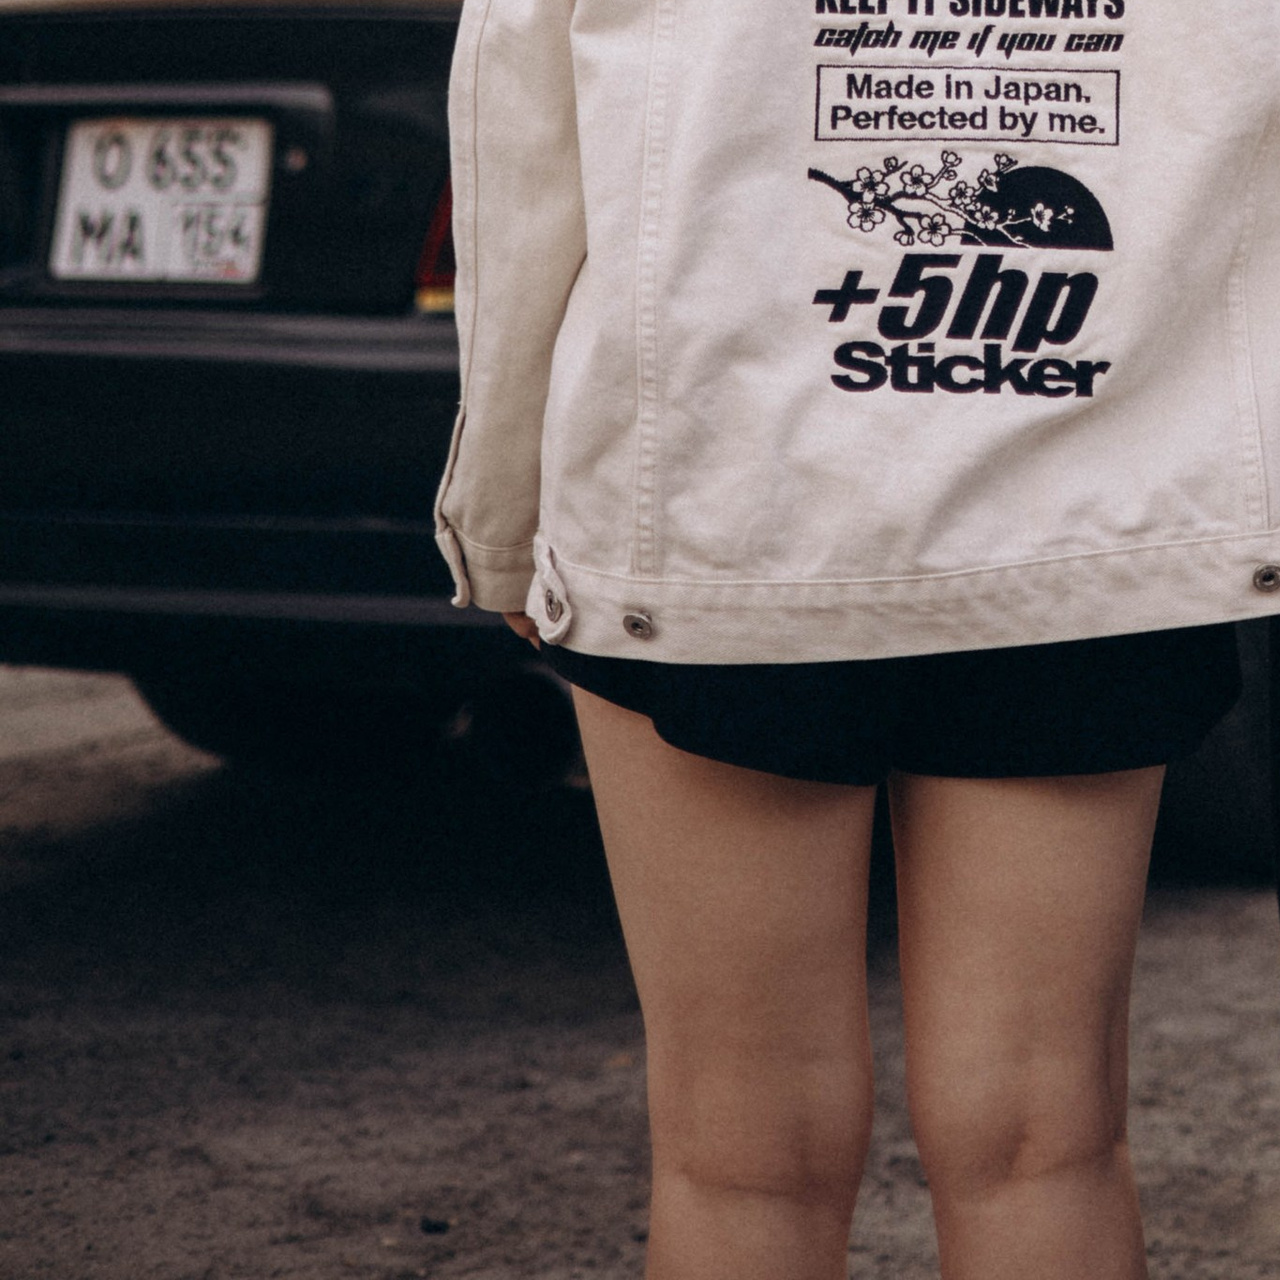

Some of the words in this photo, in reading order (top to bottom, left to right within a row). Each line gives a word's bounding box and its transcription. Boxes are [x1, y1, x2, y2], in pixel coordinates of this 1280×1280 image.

[813, 20, 903, 57] catch
[908, 30, 961, 58] me
[966, 24, 997, 58] if
[996, 32, 1057, 60] you
[1063, 33, 1125, 53] can
[846, 73, 935, 100] Made
[945, 73, 973, 100] in
[984, 75, 1092, 105] Japan.
[830, 104, 988, 131] Perfected
[999, 104, 1038, 137] by
[1048, 112, 1106, 134] me.
[812, 253, 1099, 353] +5hp
[830, 340, 1112, 398] Sticker
